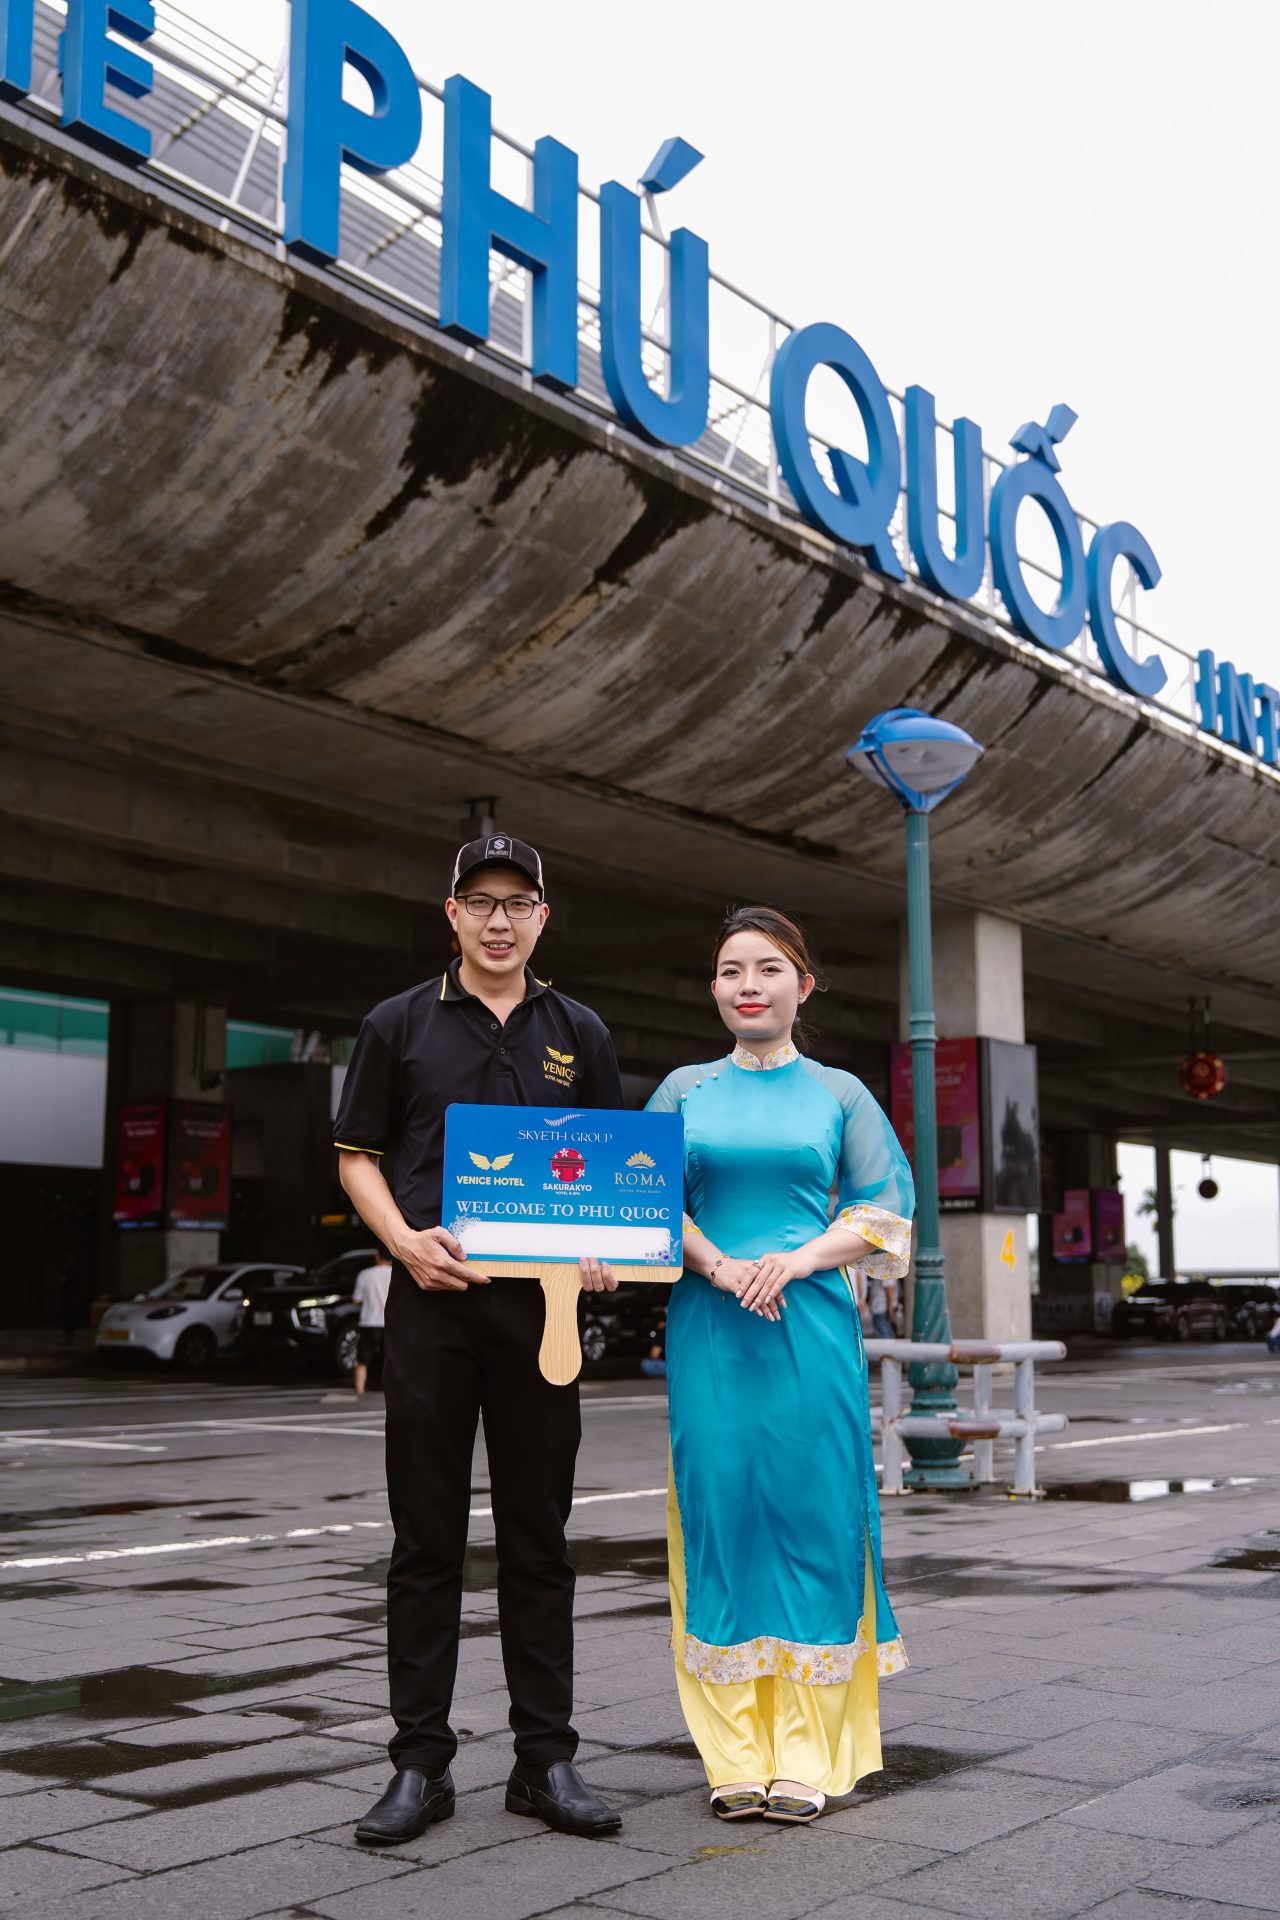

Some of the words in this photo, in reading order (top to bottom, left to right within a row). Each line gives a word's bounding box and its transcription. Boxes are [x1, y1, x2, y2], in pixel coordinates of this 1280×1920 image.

[283, 0, 709, 447] PHÚ
[769, 322, 1168, 698] QUỐC
[543, 1060, 576, 1082] VENICE
[518, 1129, 567, 1141] SKYETH
[571, 1132, 613, 1144] GROUP
[456, 1175, 491, 1185] VENICE
[493, 1177, 525, 1187] HOTEL
[542, 1182, 593, 1192] SAKURAKYO
[614, 1172, 667, 1187] ROMA
[456, 1200, 546, 1217] WELCOME
[549, 1203, 574, 1216] TO
[578, 1205, 615, 1219] PHU
[619, 1206, 670, 1222] QUOC
[1001, 1228, 1016, 1273] 4
